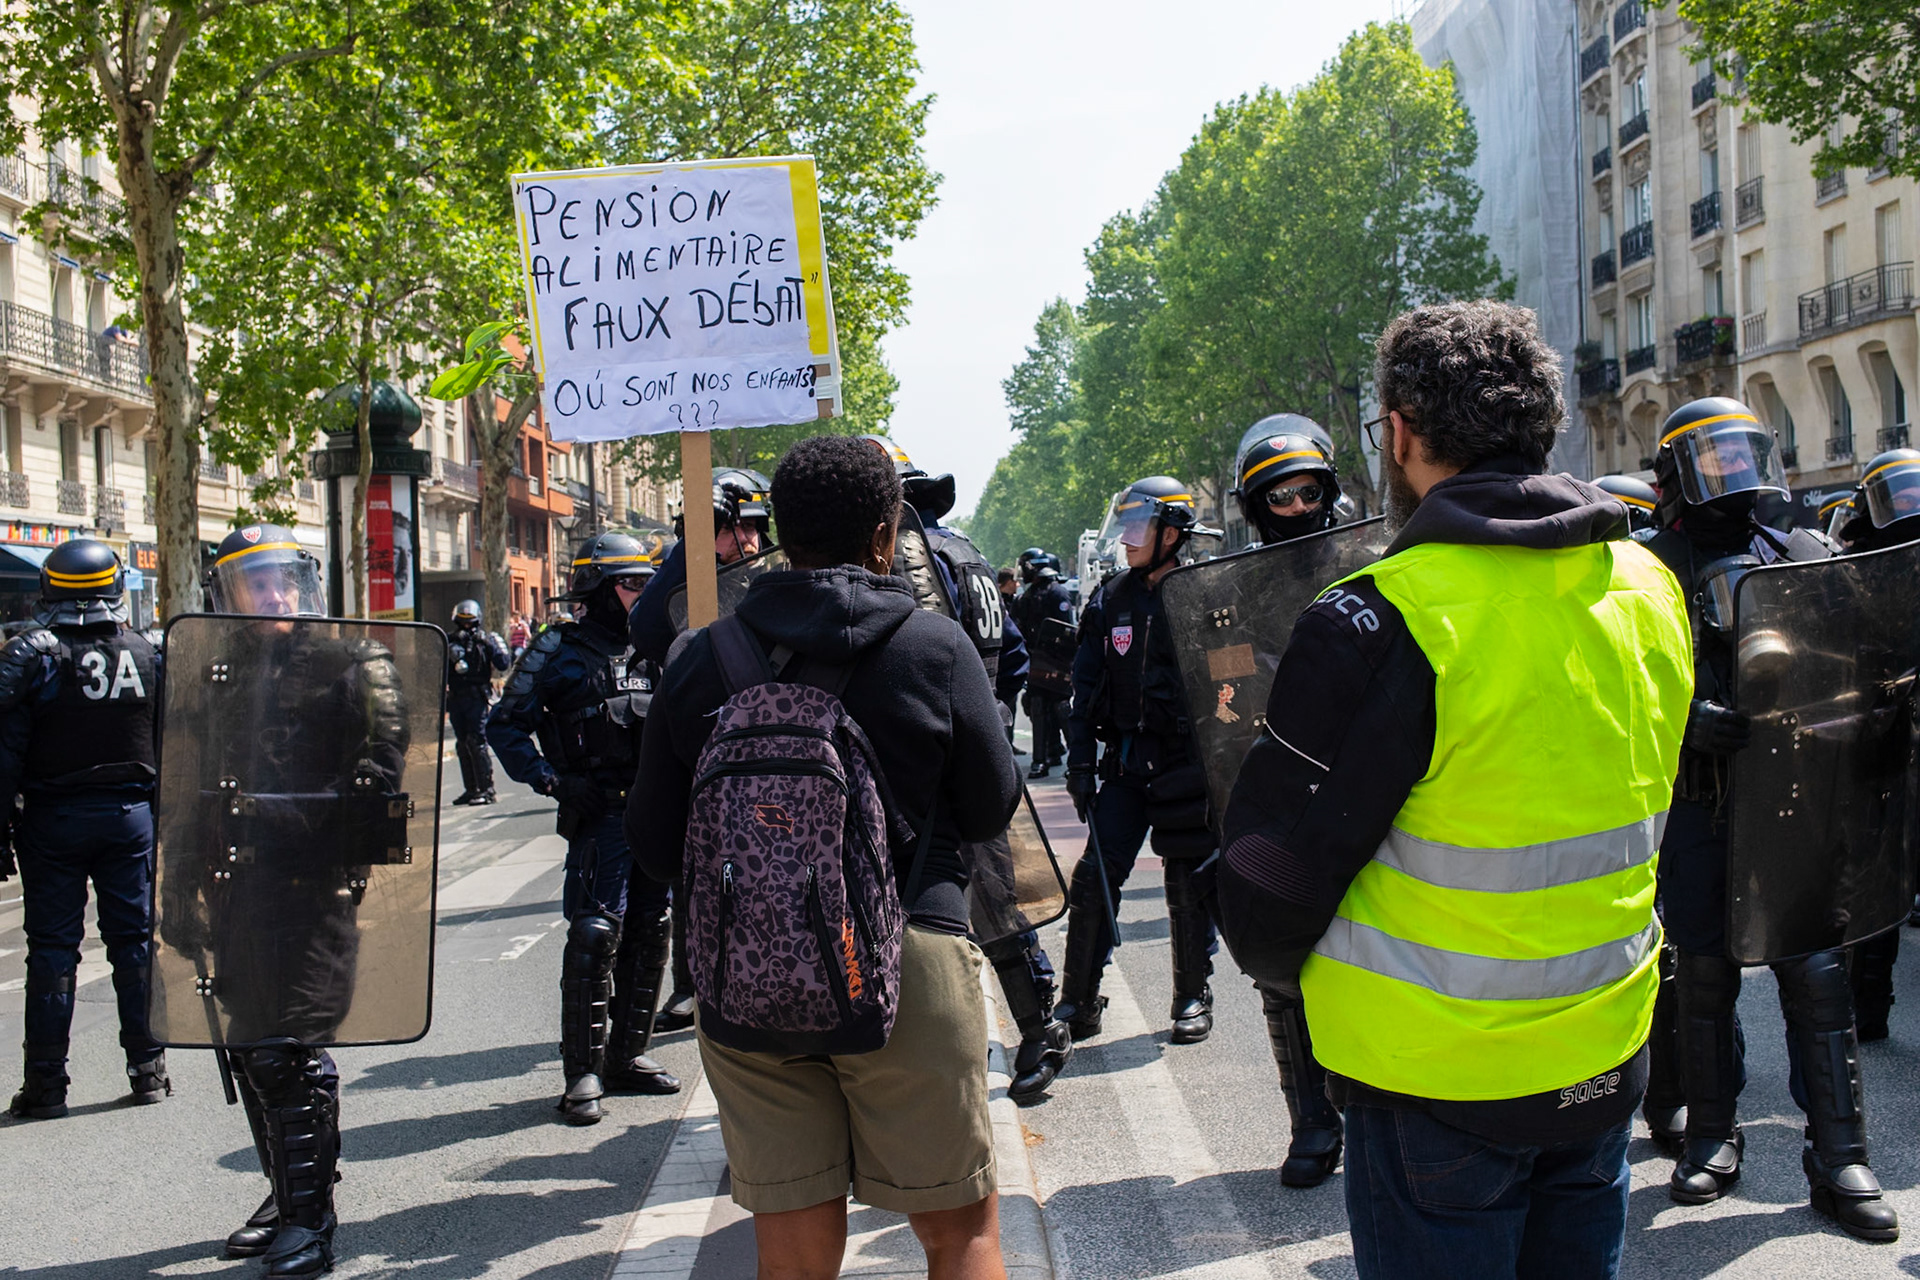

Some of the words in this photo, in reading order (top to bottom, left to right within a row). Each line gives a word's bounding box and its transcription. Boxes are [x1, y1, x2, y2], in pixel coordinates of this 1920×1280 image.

[564, 296, 671, 351] FAUX
[622, 371, 679, 407] SONT
[692, 372, 733, 395] NOS
[136, 550, 158, 569] ELE
[971, 574, 1002, 639] 3B
[1316, 588, 1380, 635] ace
[81, 649, 146, 700] 3A
[1557, 1071, 1621, 1109] sace
